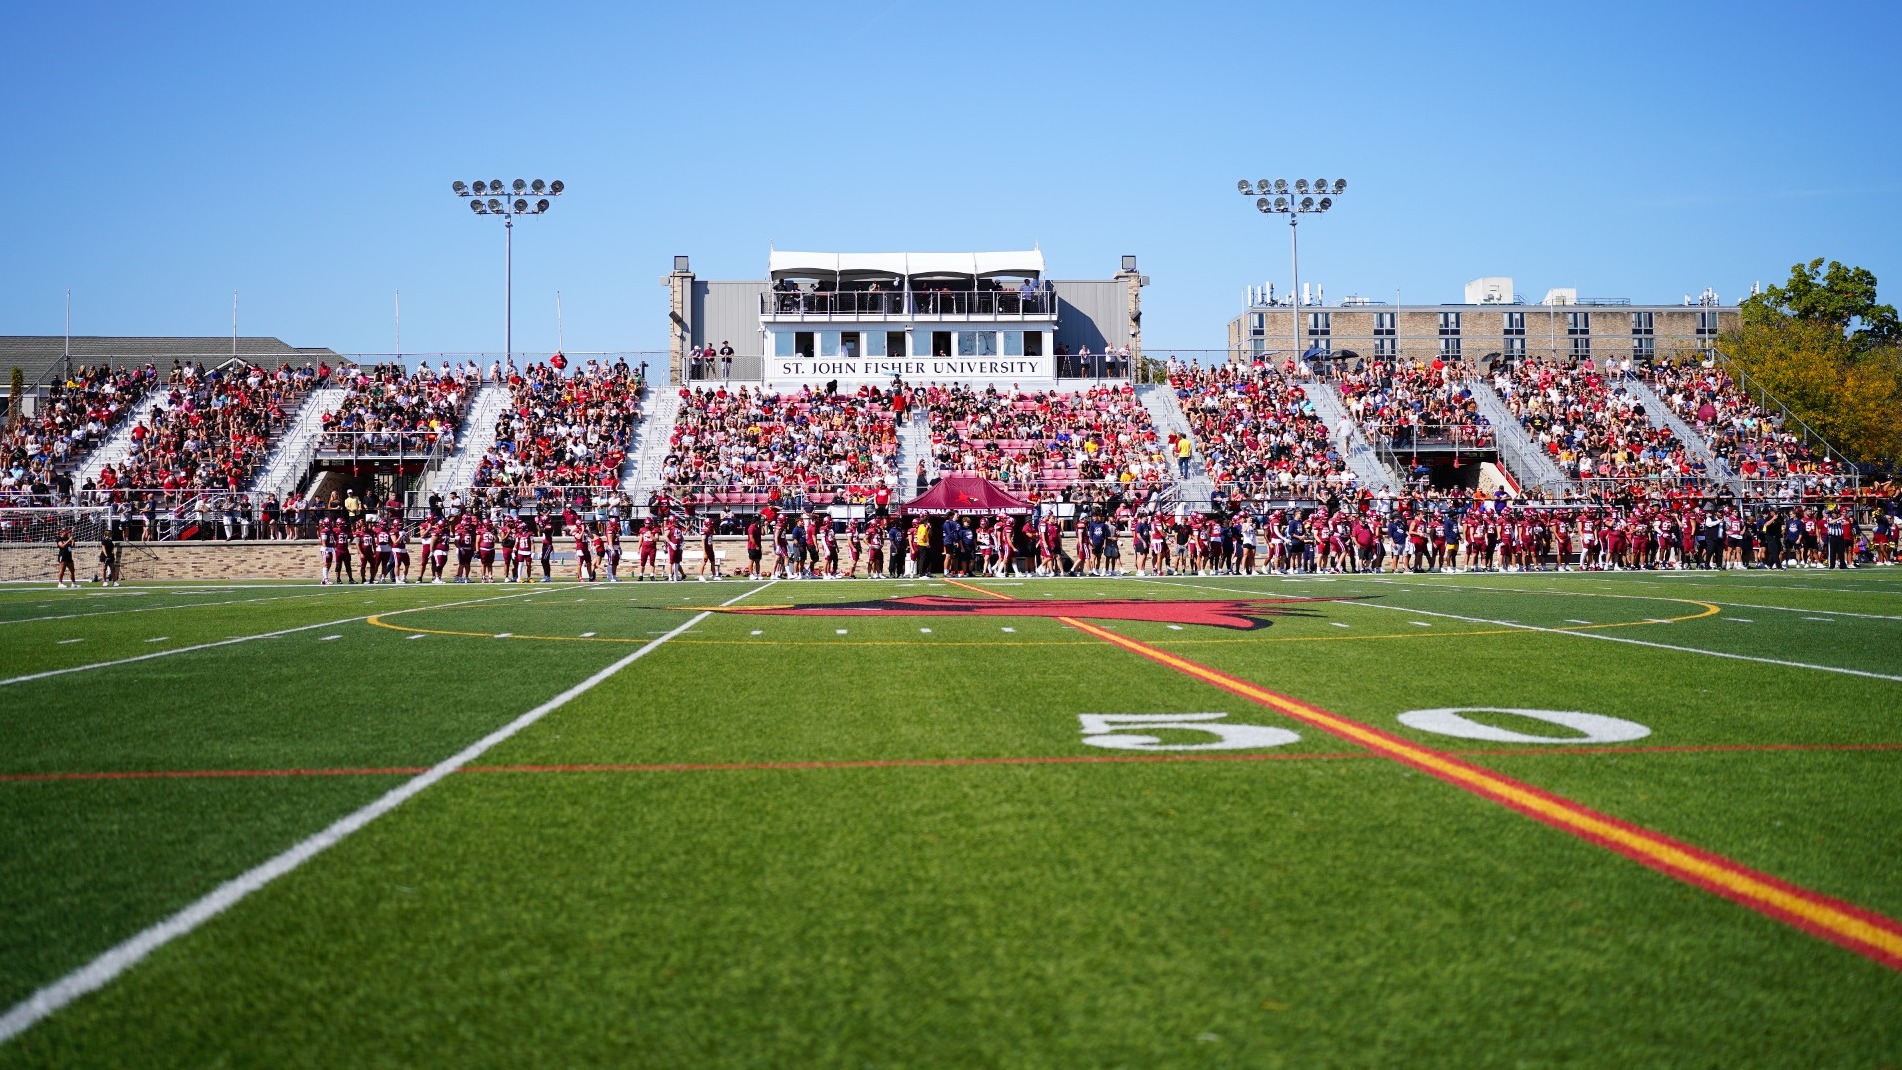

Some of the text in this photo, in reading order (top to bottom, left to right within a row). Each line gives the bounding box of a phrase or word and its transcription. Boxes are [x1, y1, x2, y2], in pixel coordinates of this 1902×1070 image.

[783, 361, 1039, 375] ST. JOHN FISHER UNIVERSITY
[990, 507, 1027, 515] TRAINING
